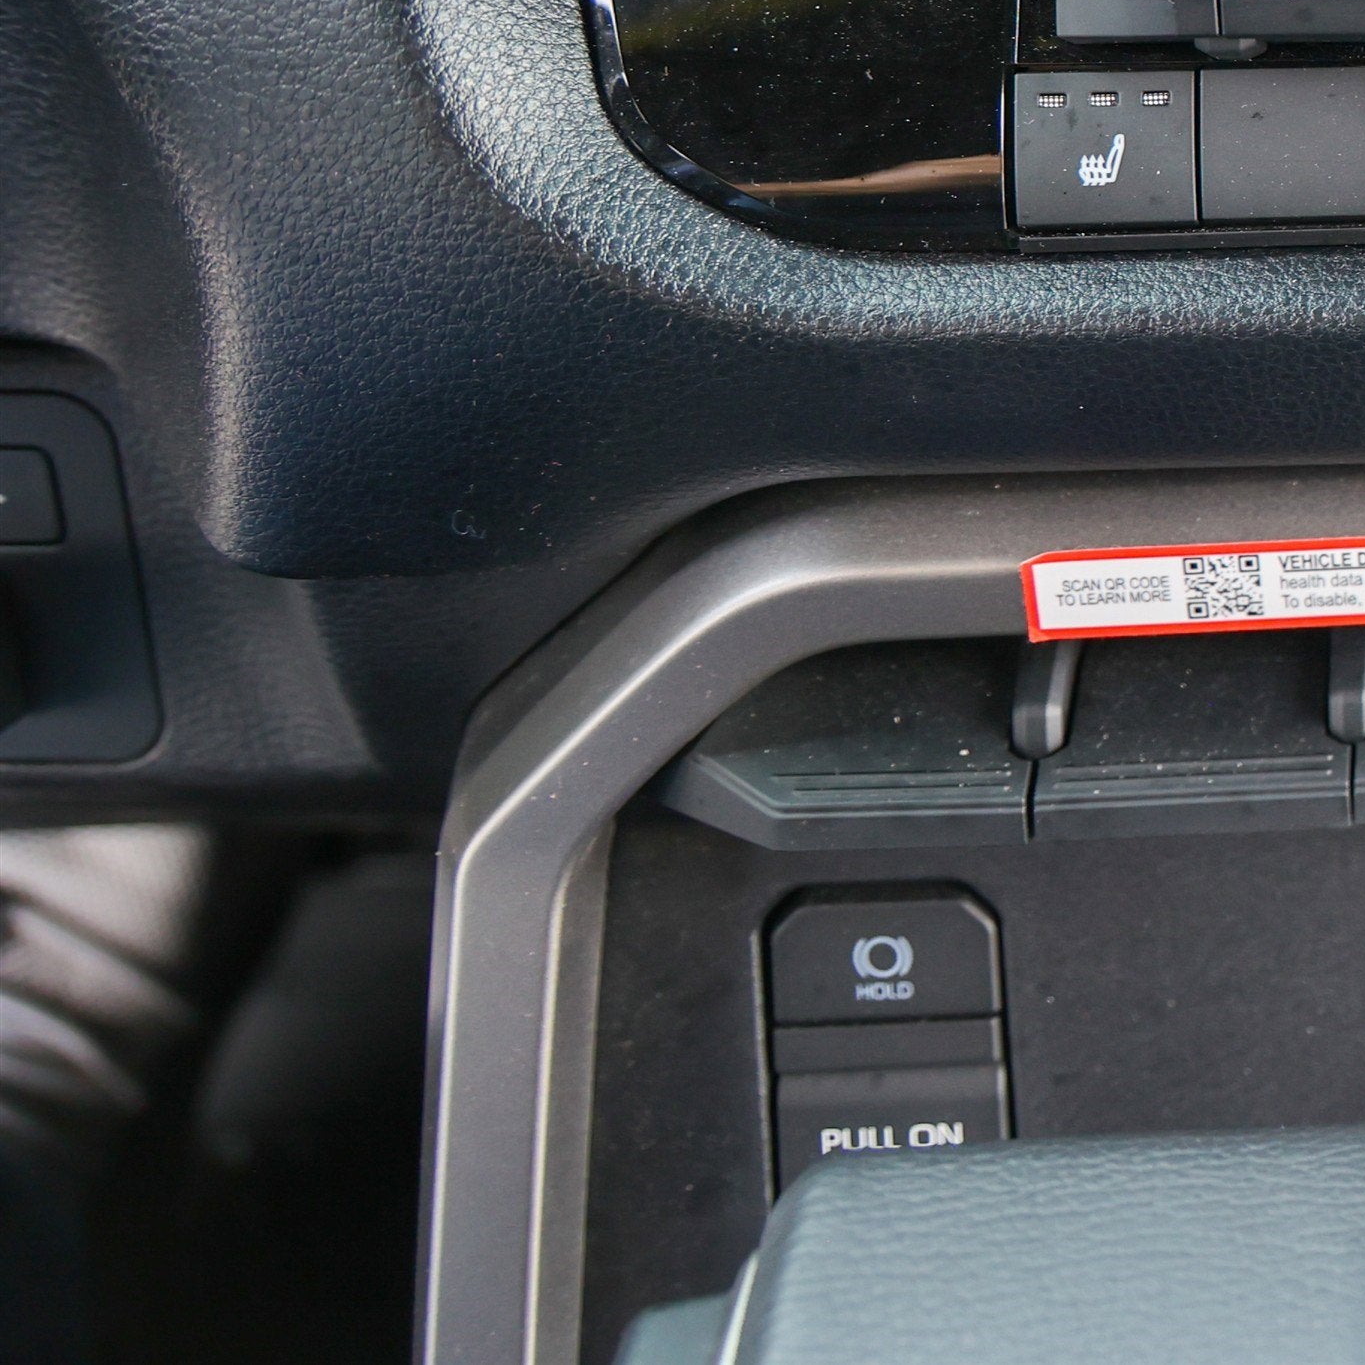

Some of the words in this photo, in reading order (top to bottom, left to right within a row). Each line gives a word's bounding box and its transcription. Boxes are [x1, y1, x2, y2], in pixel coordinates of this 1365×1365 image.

[1278, 553, 1352, 570] VEHICLE
[1061, 579, 1101, 593] SCAN
[1104, 577, 1125, 590] QR
[1129, 575, 1170, 590] CODE
[1280, 571, 1326, 589] health
[1331, 571, 1363, 586] data
[1056, 593, 1076, 606] TO
[1080, 591, 1126, 606] LEARN
[1130, 589, 1172, 603] MORE
[1282, 594, 1300, 609] To
[1304, 590, 1361, 608] disable,
[855, 981, 915, 1001] HOLD
[821, 1126, 902, 1155] PULL
[909, 1122, 964, 1147] ON
